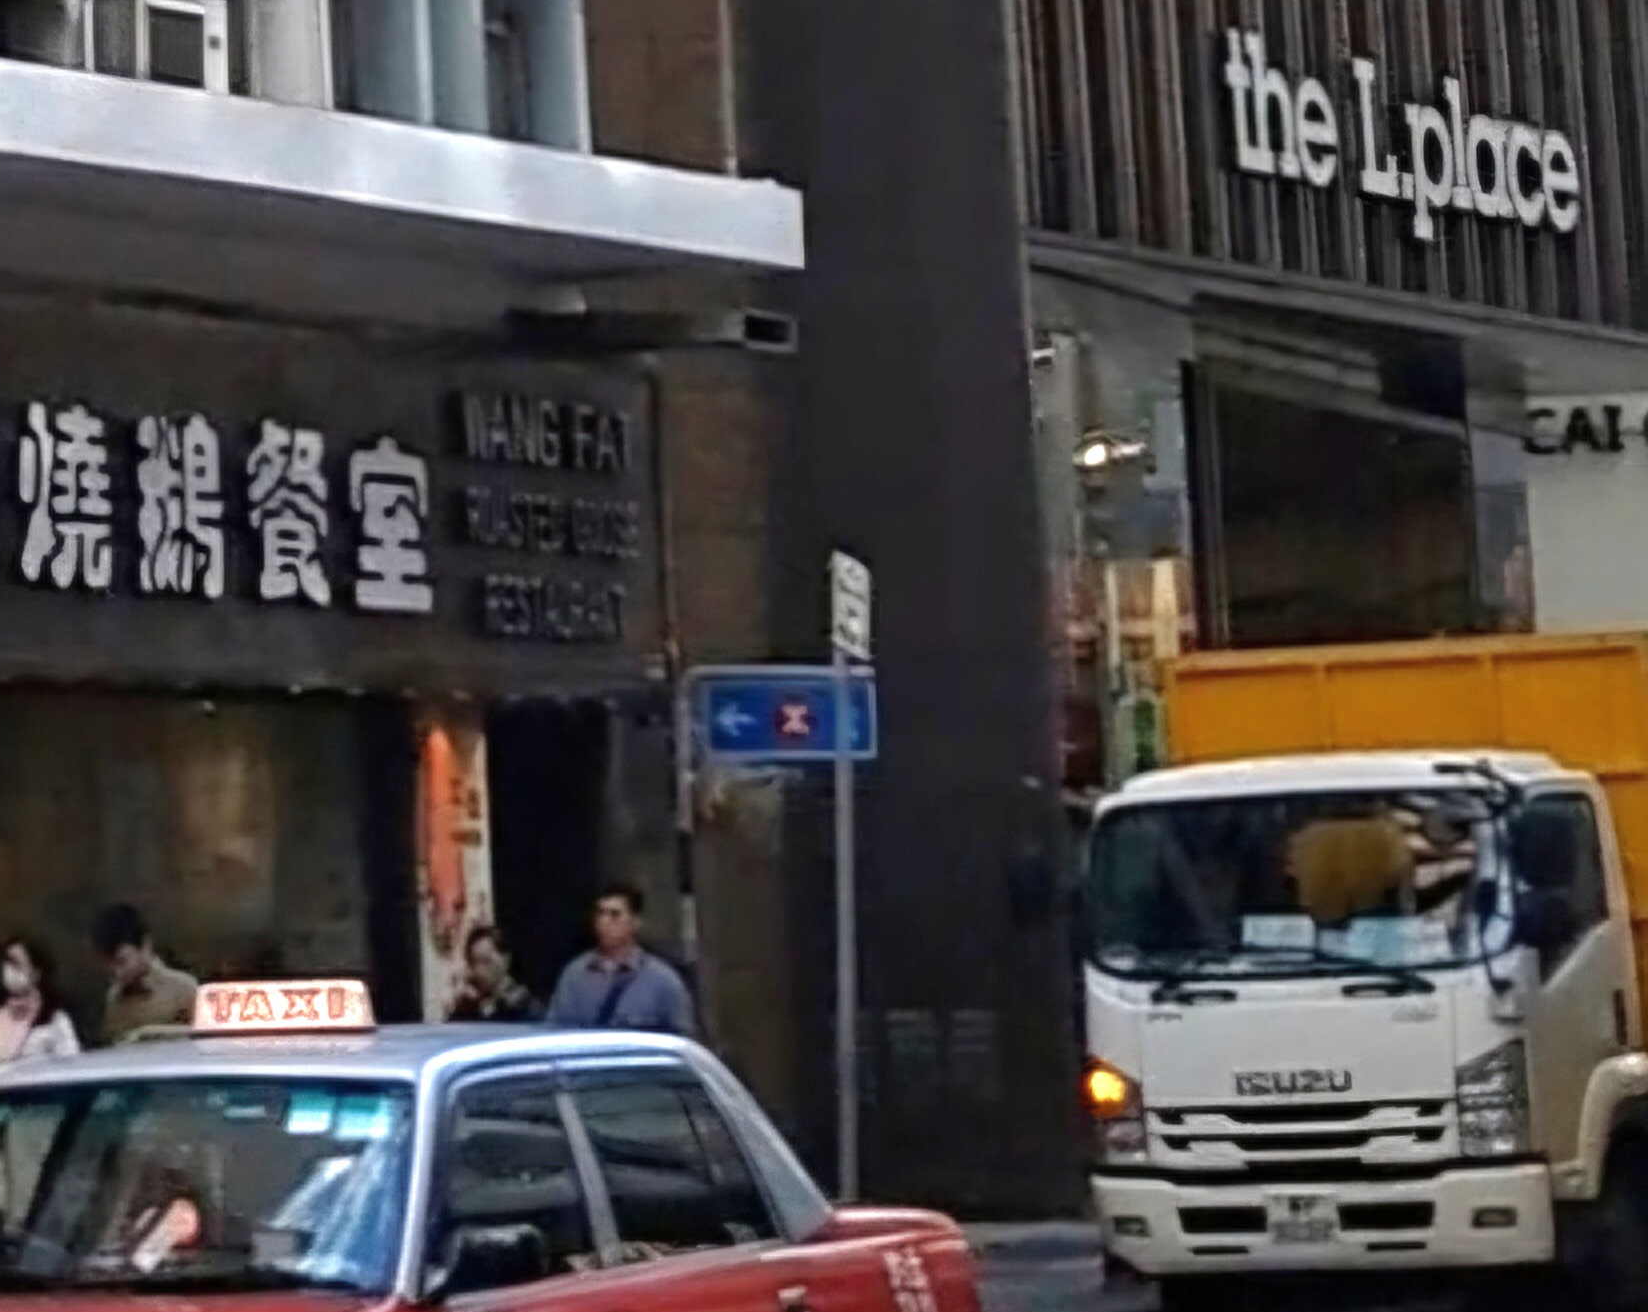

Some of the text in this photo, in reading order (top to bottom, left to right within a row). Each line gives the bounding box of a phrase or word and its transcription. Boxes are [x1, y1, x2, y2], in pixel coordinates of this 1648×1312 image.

[1224, 26, 1339, 187] the
[575, 402, 633, 472] FAT
[204, 986, 348, 1022] TAXI
[1235, 1068, 1353, 1096] ISUZU
